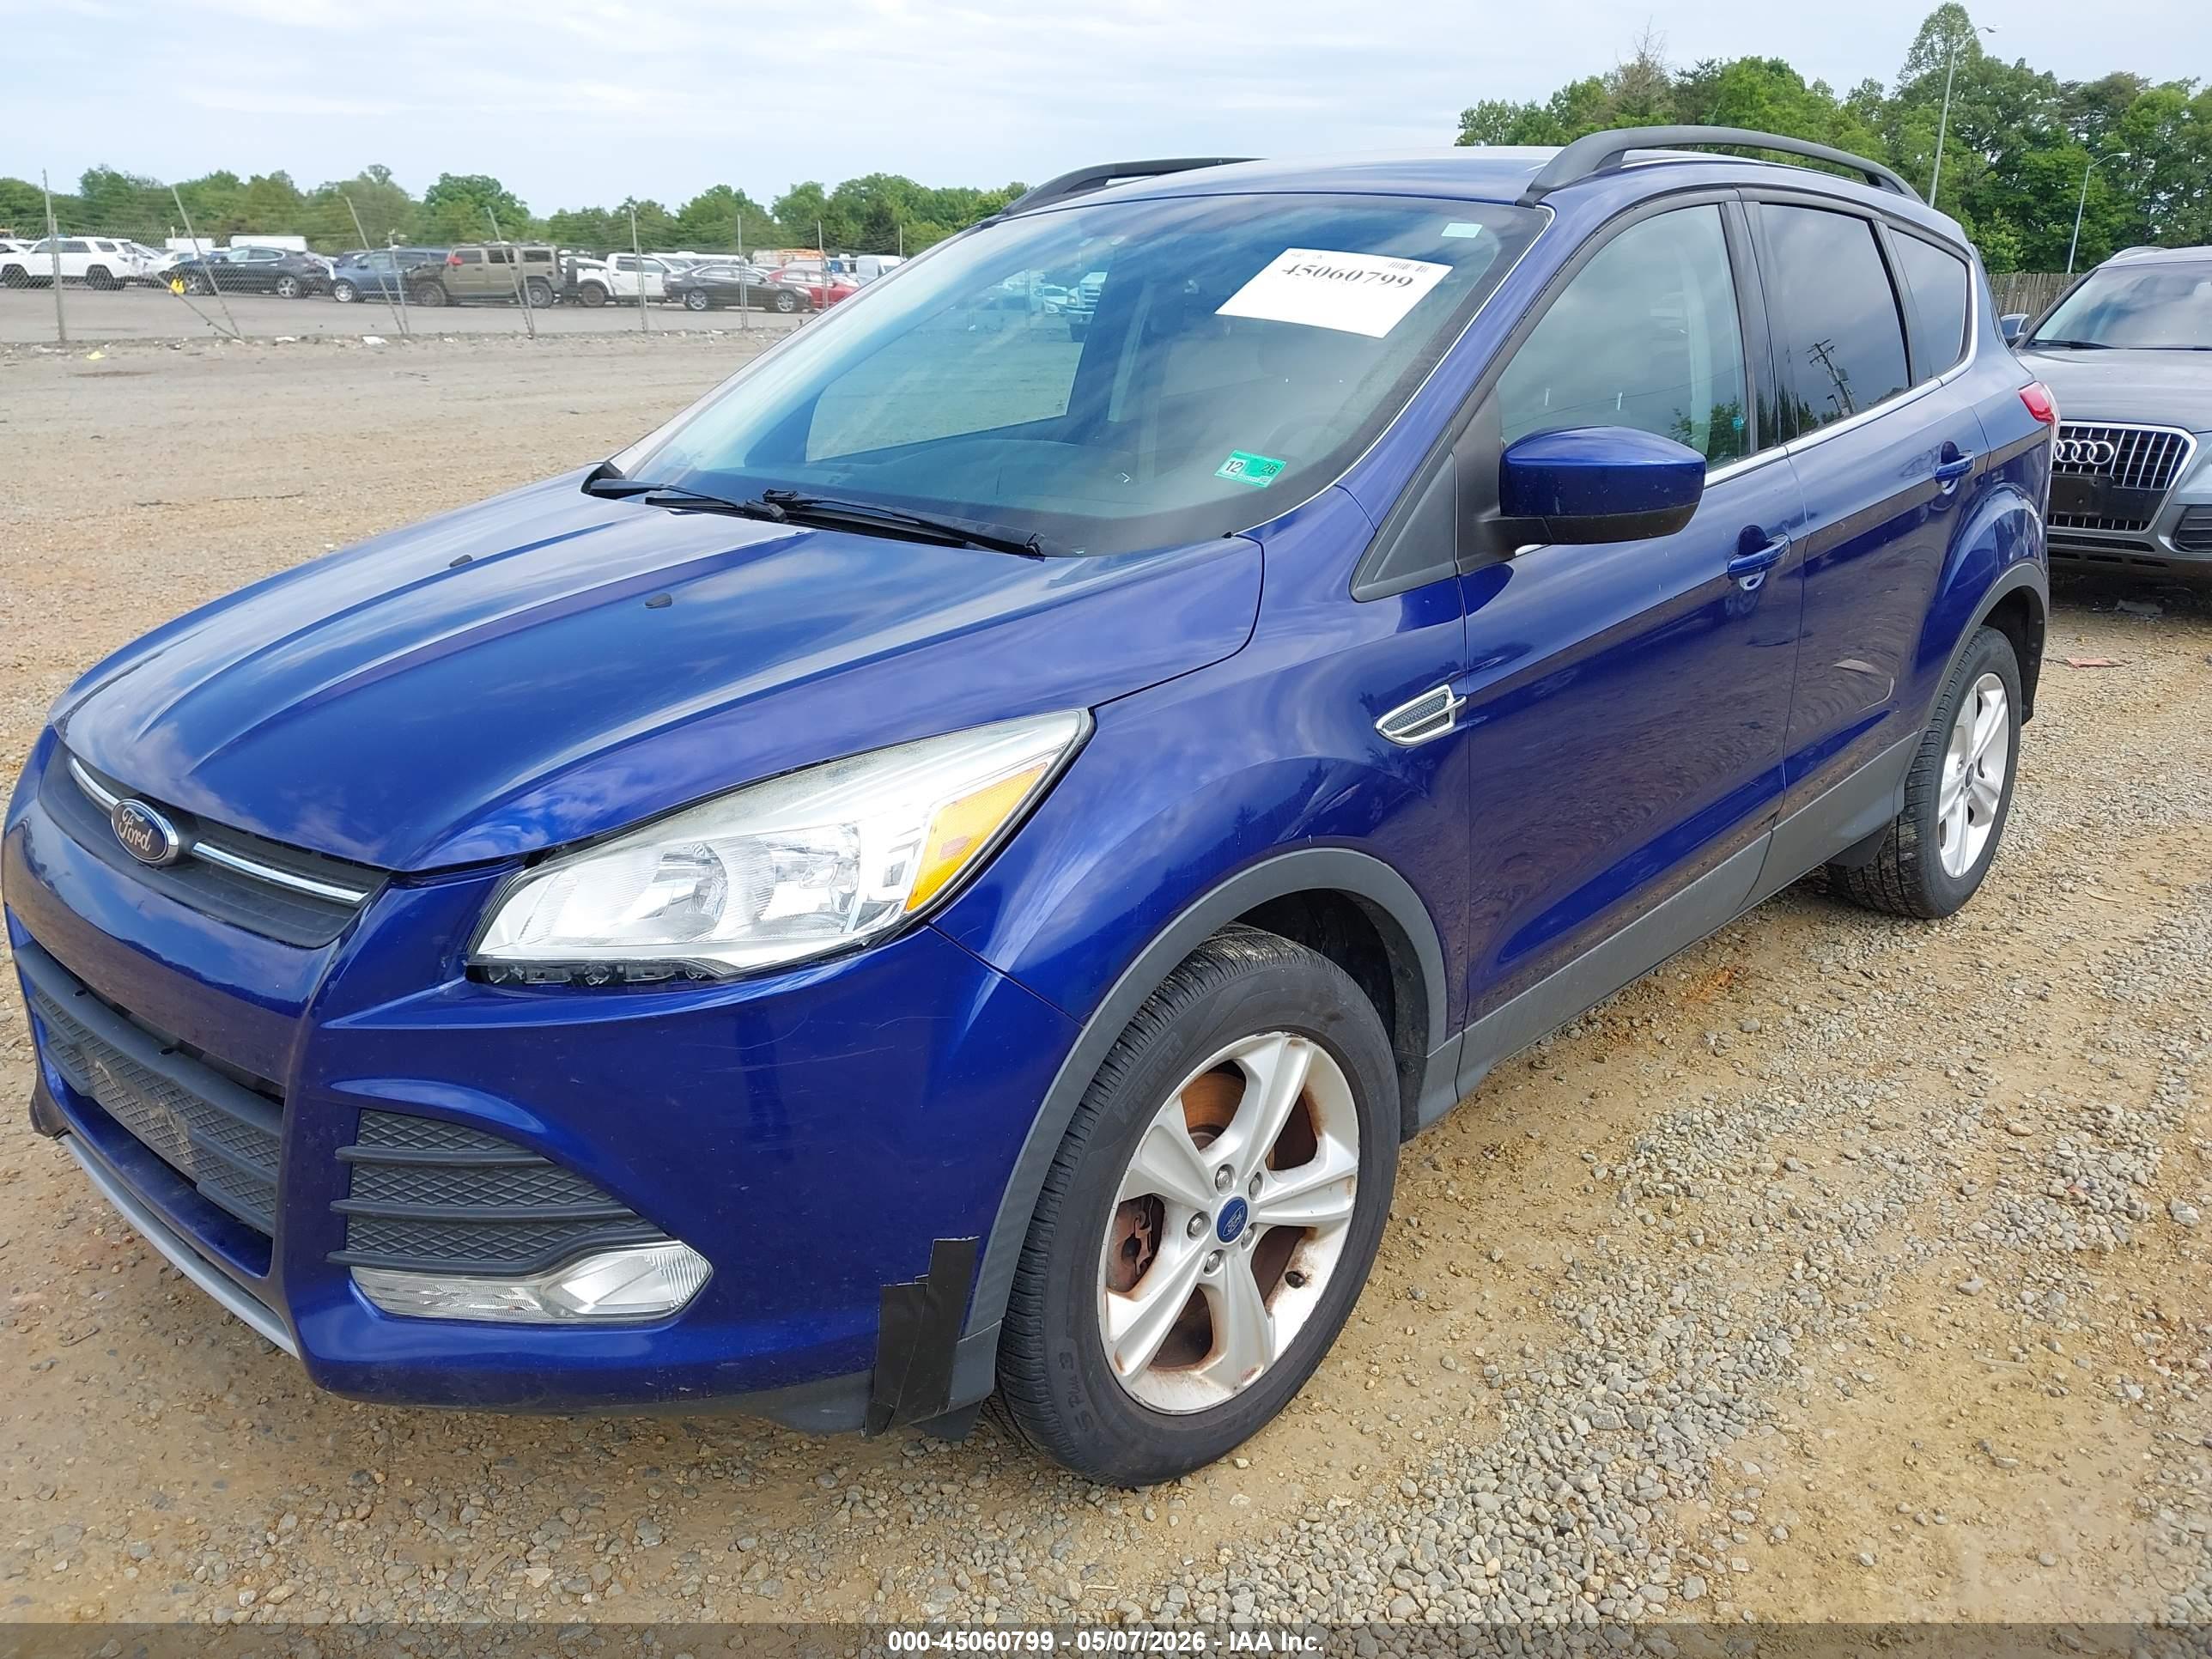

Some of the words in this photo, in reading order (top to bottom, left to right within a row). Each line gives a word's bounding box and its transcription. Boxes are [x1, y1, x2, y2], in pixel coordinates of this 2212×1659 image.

[1280, 262, 1414, 289] 45060799
[1225, 460, 1243, 473] 12
[1261, 462, 1279, 475] 26
[118, 807, 153, 852] Ford
